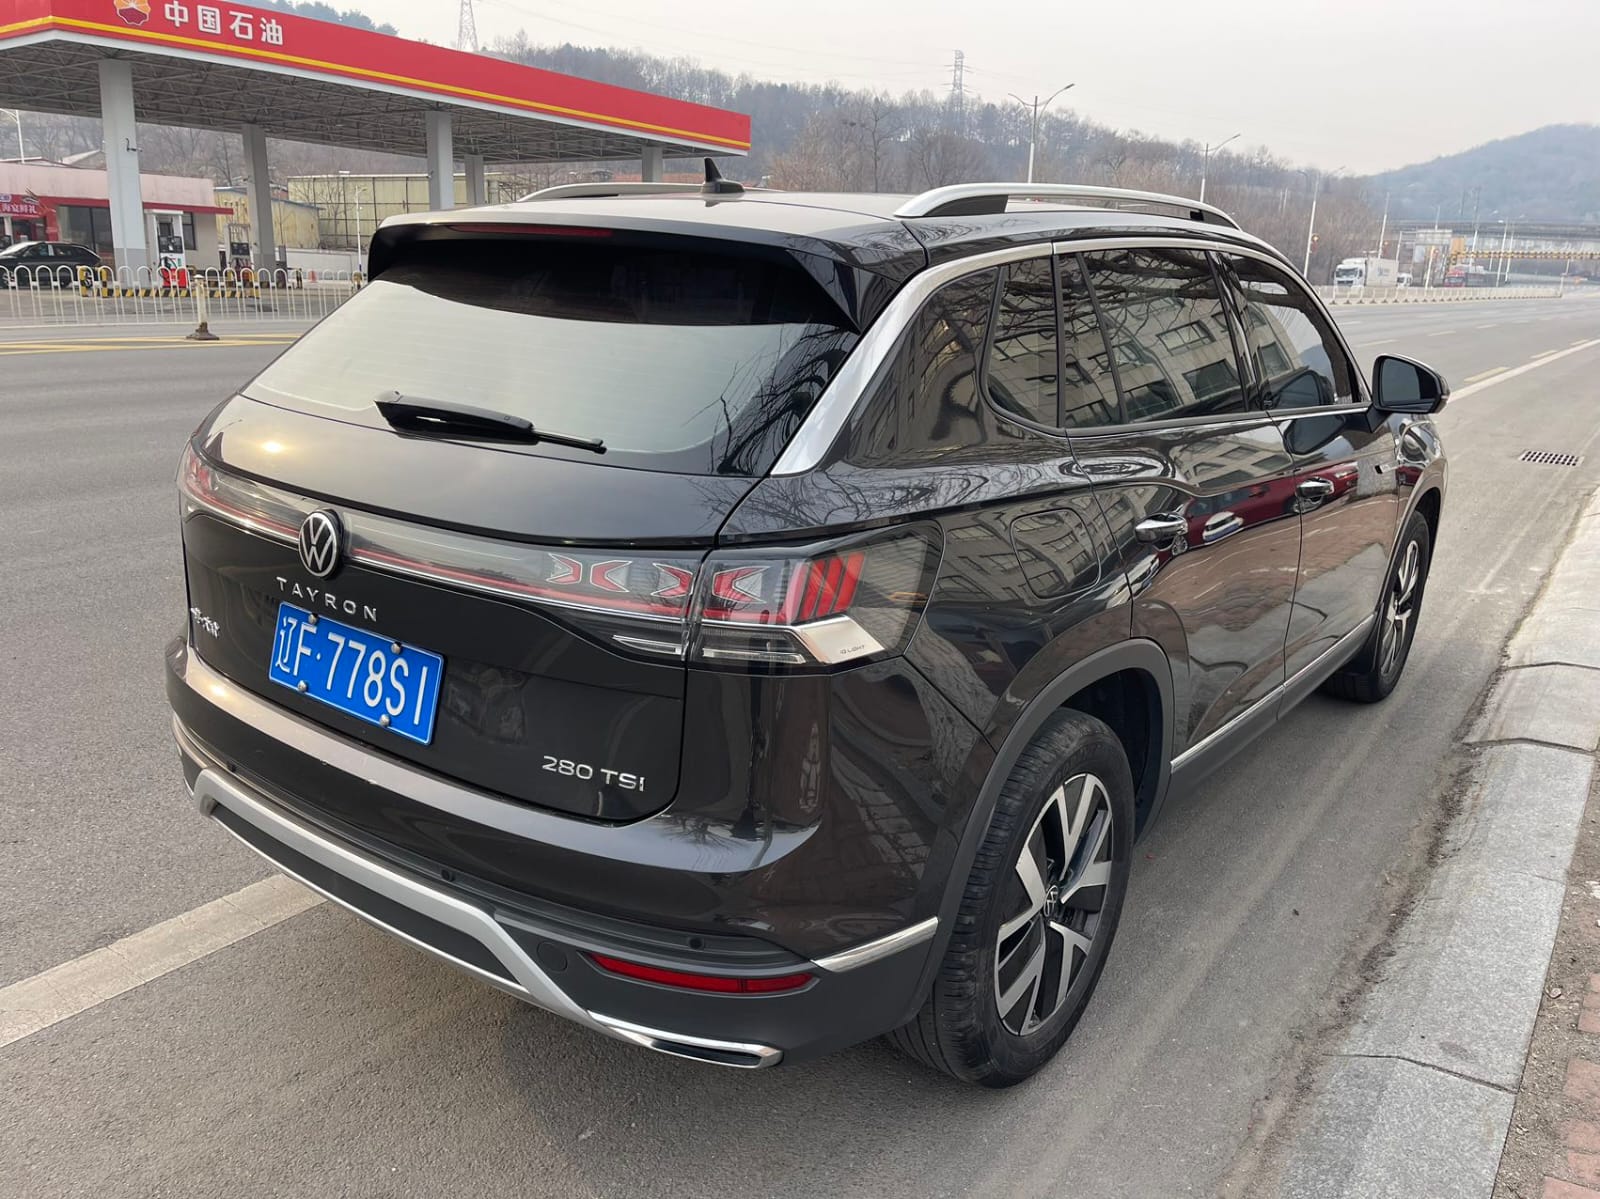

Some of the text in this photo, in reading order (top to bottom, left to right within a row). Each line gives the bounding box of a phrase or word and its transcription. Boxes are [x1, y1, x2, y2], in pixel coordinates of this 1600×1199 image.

[164, 0, 283, 45] 中国石油
[275, 576, 378, 623] TAYRON
[541, 755, 645, 792] 280 TSI
